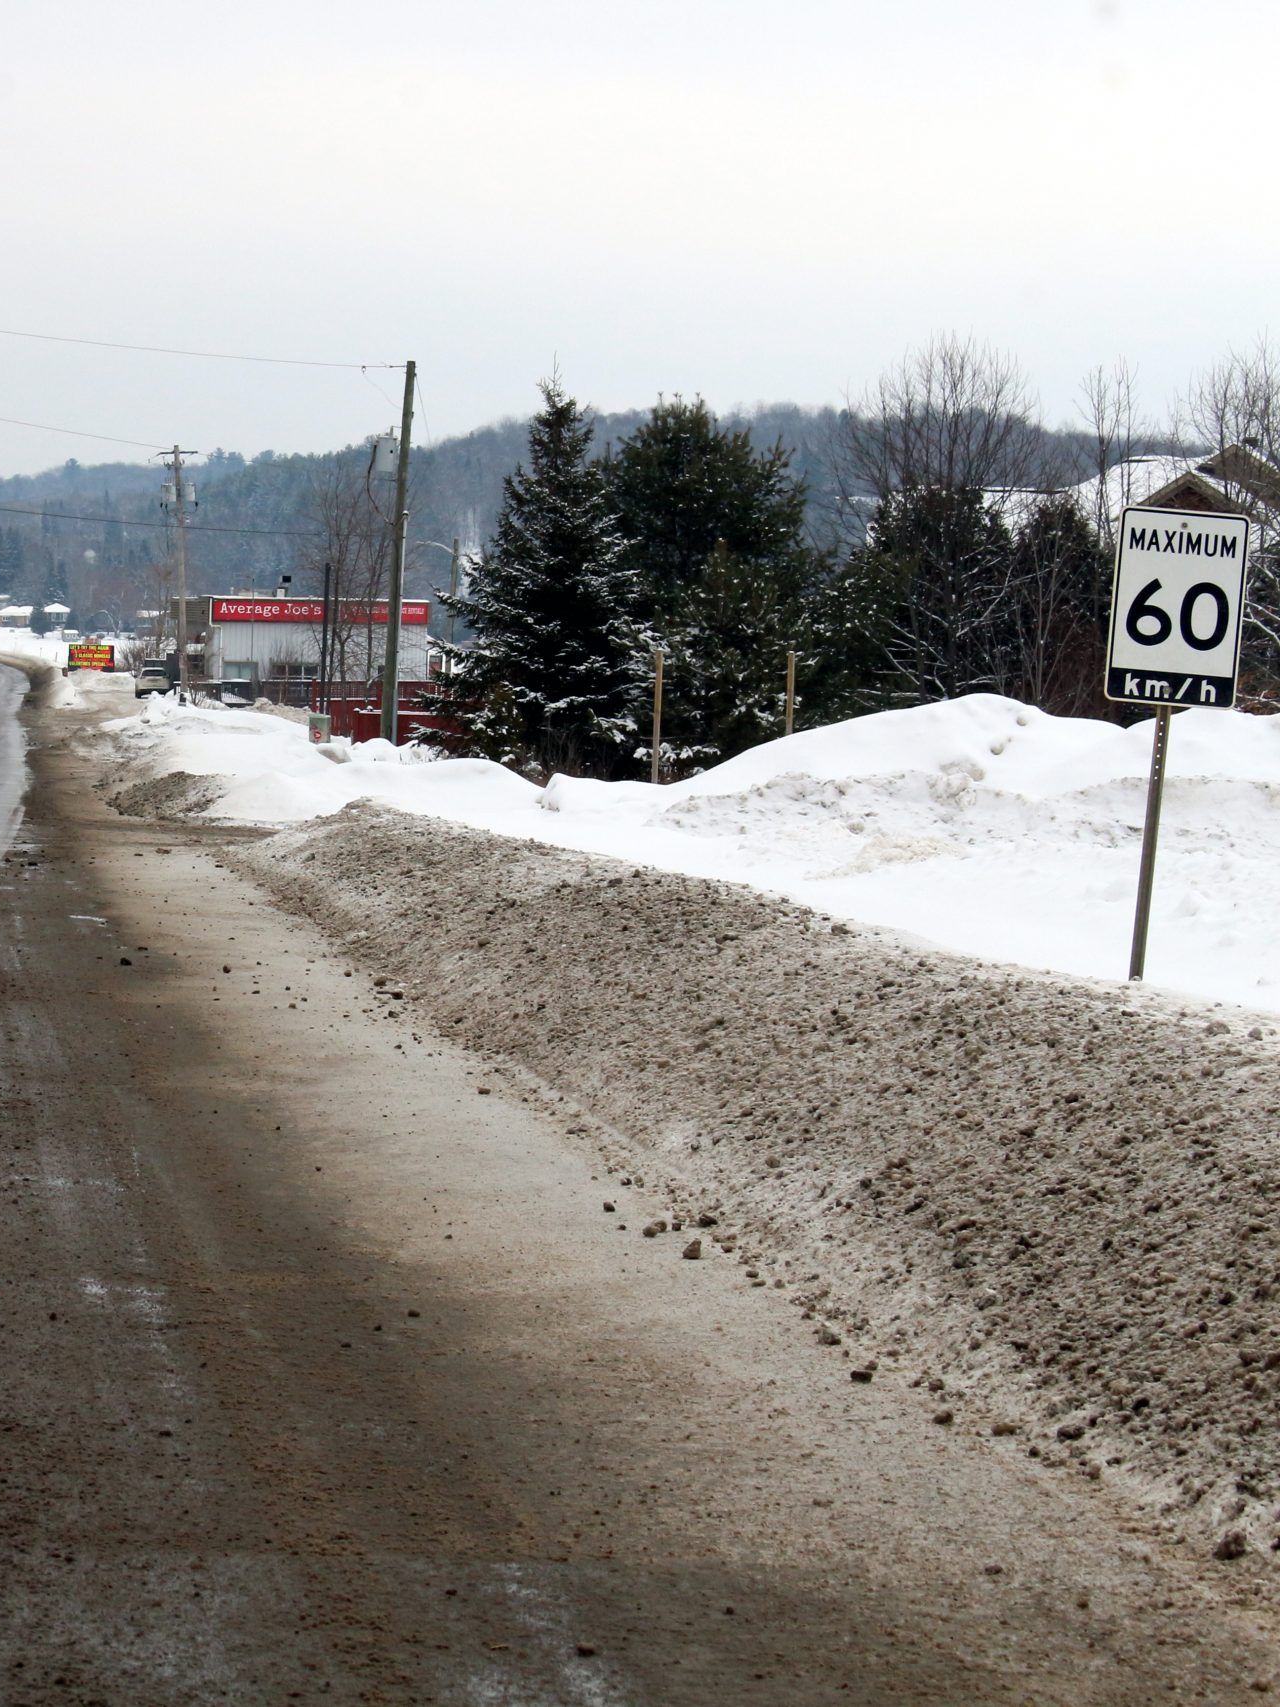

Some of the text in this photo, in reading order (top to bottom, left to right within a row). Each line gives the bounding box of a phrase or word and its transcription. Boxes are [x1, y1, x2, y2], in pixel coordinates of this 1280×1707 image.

[1129, 527, 1237, 559] MAXIMUM
[220, 602, 322, 617] Average Joe's
[1126, 578, 1230, 651] 60
[1124, 672, 1216, 703] km/h
